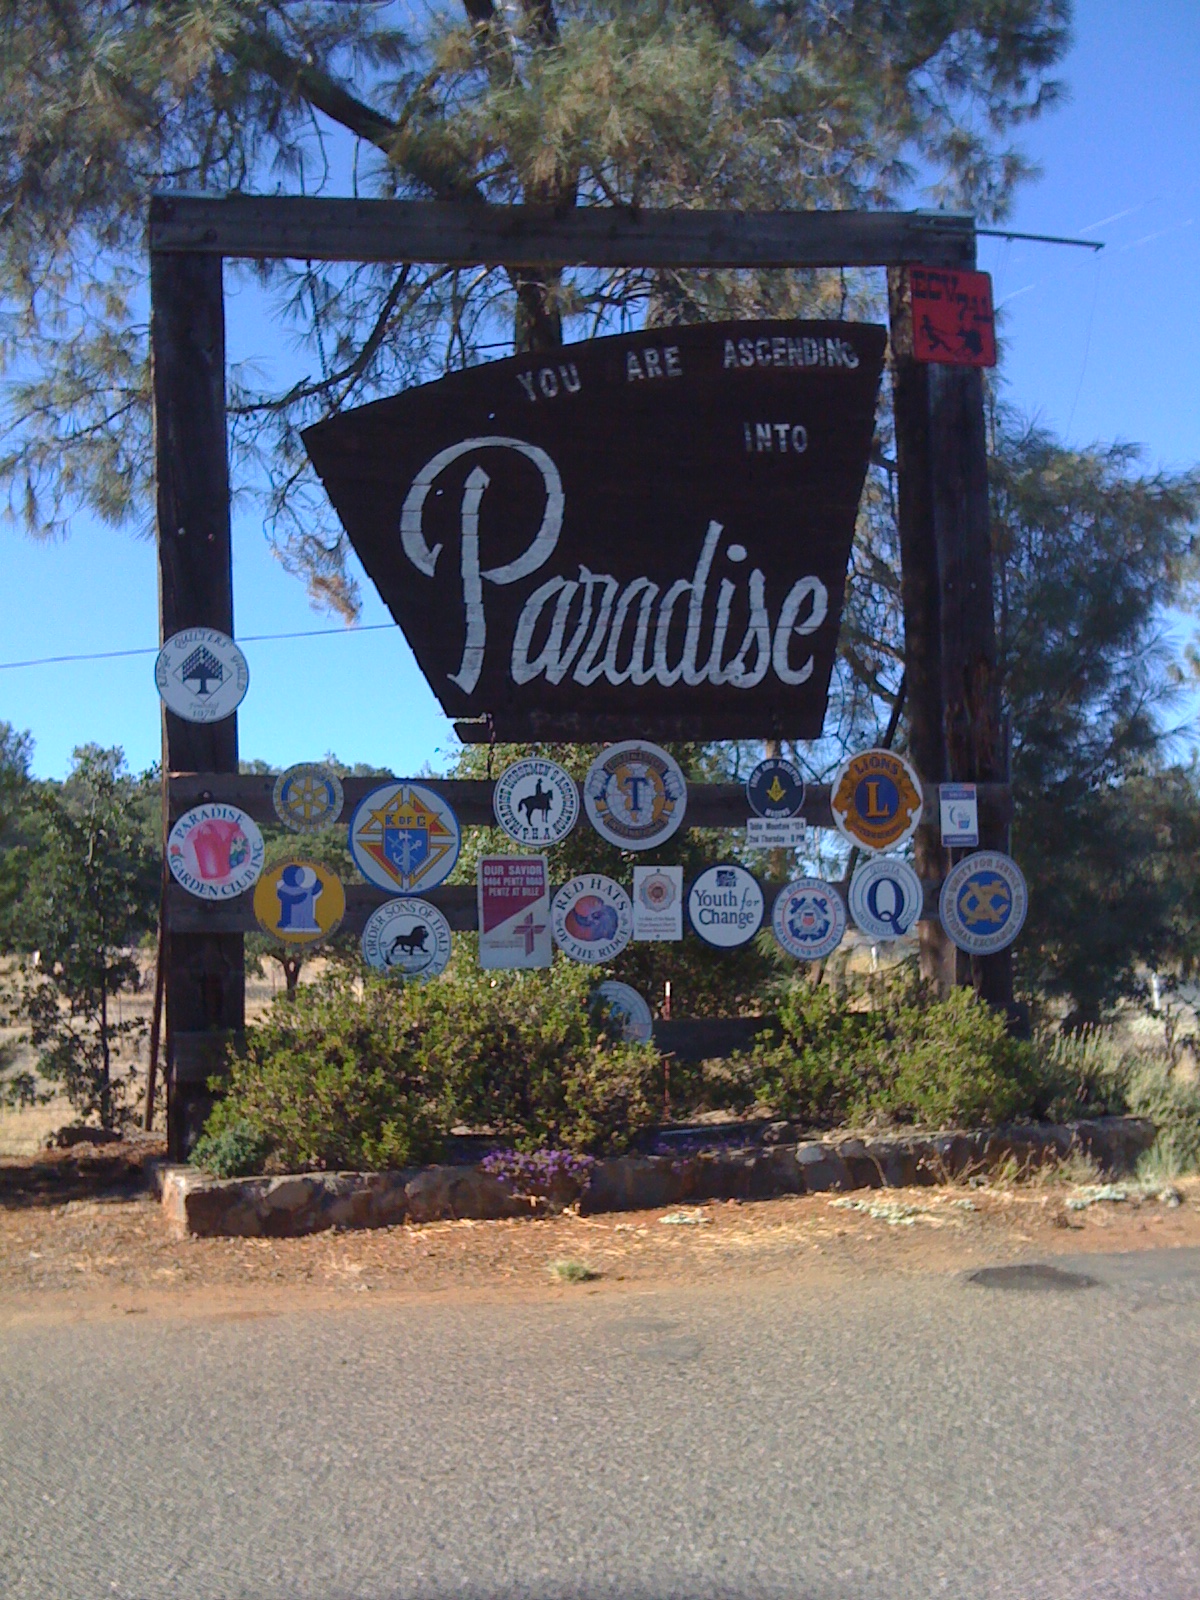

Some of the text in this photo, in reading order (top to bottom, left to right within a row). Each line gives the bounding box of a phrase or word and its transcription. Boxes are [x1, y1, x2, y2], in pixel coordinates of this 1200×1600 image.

[516, 337, 860, 401] YOU ARE ASCENDING
[744, 422, 809, 453] INTO
[399, 435, 828, 696] Paradise
[853, 756, 900, 775] LIONS
[623, 777, 649, 811] T
[865, 782, 890, 817] L
[174, 807, 245, 839] PARADISE
[385, 814, 396, 825] K
[417, 815, 426, 826] C
[499, 788, 523, 835] PARADISE
[171, 857, 219, 896] GARDEN
[221, 869, 256, 895] CLUB
[484, 865, 543, 876] OUR SAVIOR
[512, 887, 520, 897] AT
[556, 878, 628, 911] RED HATS
[694, 889, 738, 907] Youth
[739, 887, 761, 911] for
[866, 878, 909, 935] Q
[367, 915, 386, 957] ORDER
[385, 901, 416, 918] SONS
[418, 905, 434, 919] OF
[699, 908, 754, 929] Change
[556, 927, 630, 959] OF THE RIDGE
